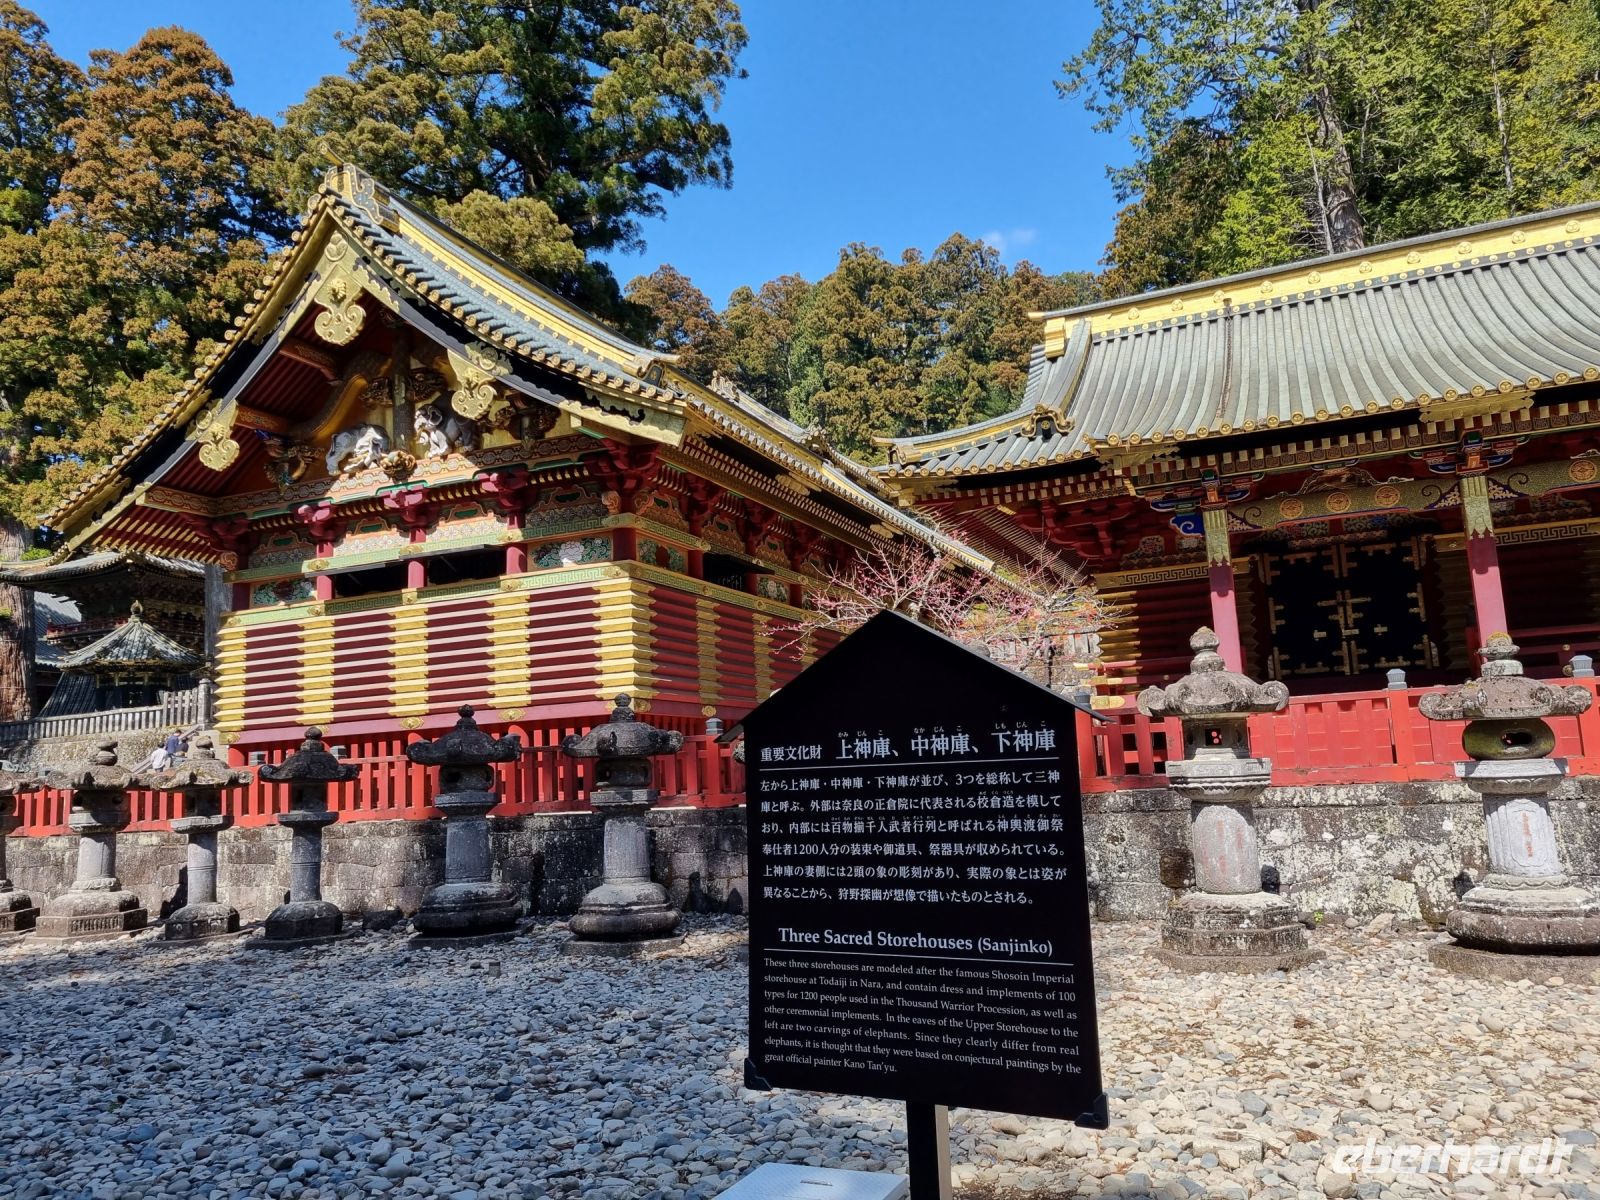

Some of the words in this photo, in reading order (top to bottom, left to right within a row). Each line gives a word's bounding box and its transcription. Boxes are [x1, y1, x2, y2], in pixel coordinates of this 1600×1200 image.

[760, 745, 822, 762] 重要文化財
[779, 928, 819, 943] Three
[824, 930, 873, 945] Sacred
[878, 932, 972, 949] Storehouses
[978, 938, 1052, 957] (Sanjinko)
[764, 958, 786, 966] These
[789, 960, 809, 968] three
[811, 961, 858, 970] storehouses
[877, 965, 913, 973] modeled
[916, 967, 936, 975] after
[940, 968, 953, 976] the
[956, 968, 989, 978] famous
[992, 971, 1029, 980] Shosoin
[1033, 973, 1073, 984] Imperial
[765, 975, 806, 983] storehouse
[819, 977, 846, 988] Todaiji
[861, 979, 883, 988] Nara,
[886, 981, 902, 989] and
[940, 984, 963, 993] dress
[987, 988, 1042, 999] implements
[1046, 991, 1055, 999] of
[1060, 992, 1075, 1001] 100
[765, 991, 784, 1000] types
[801, 992, 817, 1000] 1200
[820, 994, 846, 1004] people
[849, 995, 867, 1003] used
[871, 996, 878, 1004] in
[881, 997, 894, 1005] the
[896, 998, 938, 1008] Thousand
[941, 1001, 974, 1011] Warrior
[978, 1004, 1028, 1016] Procession,
[1044, 1009, 1063, 1018] well
[832, 1010, 881, 1020] implements.
[887, 1013, 894, 1021] In
[897, 1014, 910, 1023] the
[938, 1018, 946, 1026] of
[950, 1018, 963, 1027] the
[966, 1020, 994, 1031] Upper
[997, 1022, 1048, 1034] Storehouse
[1064, 1028, 1078, 1037] the
[814, 1026, 850, 1036] carvings
[854, 1027, 861, 1035] of
[865, 1028, 909, 1039] elephants.
[916, 1032, 939, 1042] Since
[943, 1035, 962, 1047] they
[966, 1037, 997, 1050] clearly
[1002, 1040, 1028, 1050] differ
[1033, 1042, 1056, 1053] from
[1060, 1046, 1078, 1055] real
[765, 1037, 803, 1047] elephants,
[814, 1040, 819, 1048] is
[822, 1041, 852, 1053] thought
[855, 1044, 870, 1052] that
[873, 1045, 890, 1057] they
[916, 1049, 939, 1059] based
[955, 1054, 1003, 1065] conjectural
[1006, 1059, 1048, 1072] paintings
[1052, 1062, 1062, 1074] by
[1066, 1064, 1080, 1073] the
[765, 1055, 783, 1063] great
[786, 1054, 811, 1063] official
[814, 1057, 841, 1066] painter
[844, 1059, 865, 1068] Kano
[867, 1061, 896, 1073] Tan'yu.
